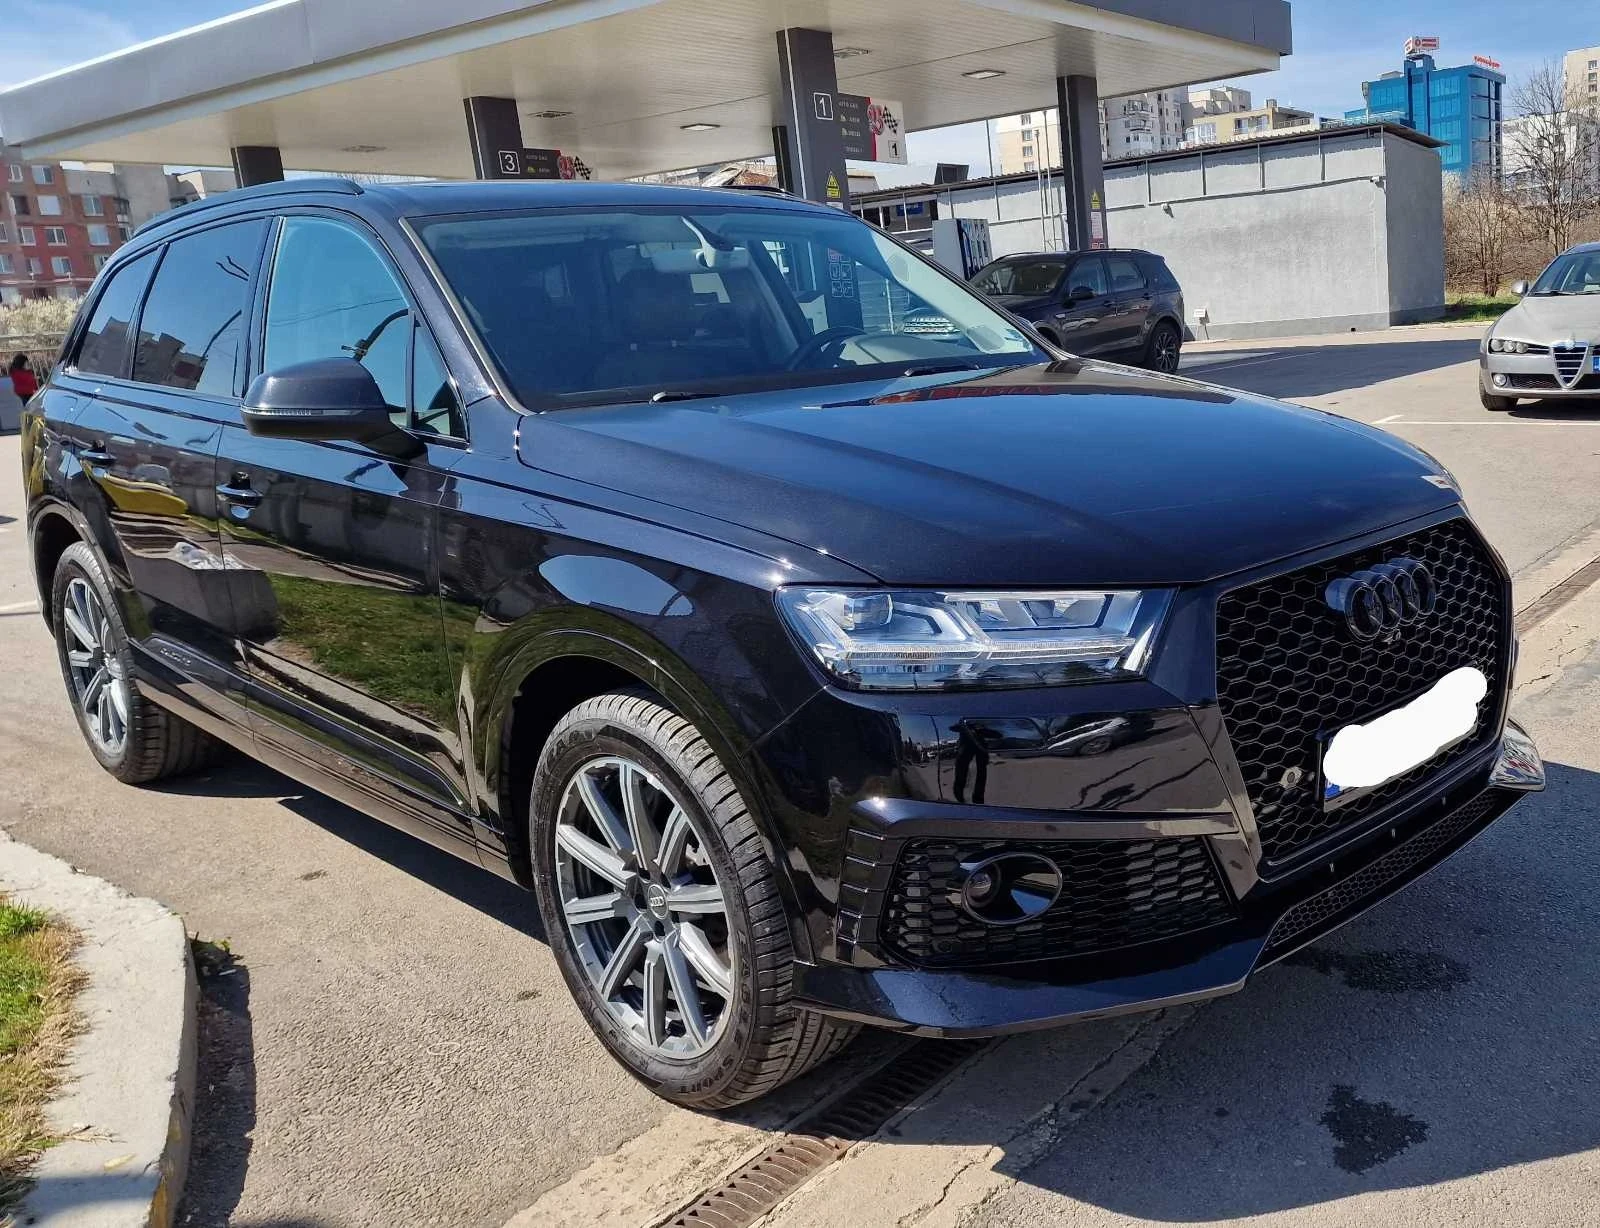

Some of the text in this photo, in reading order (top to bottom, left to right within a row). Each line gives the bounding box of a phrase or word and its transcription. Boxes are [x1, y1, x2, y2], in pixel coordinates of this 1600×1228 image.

[819, 97, 826, 116] 1
[891, 142, 898, 156] 1
[504, 154, 516, 171] 3
